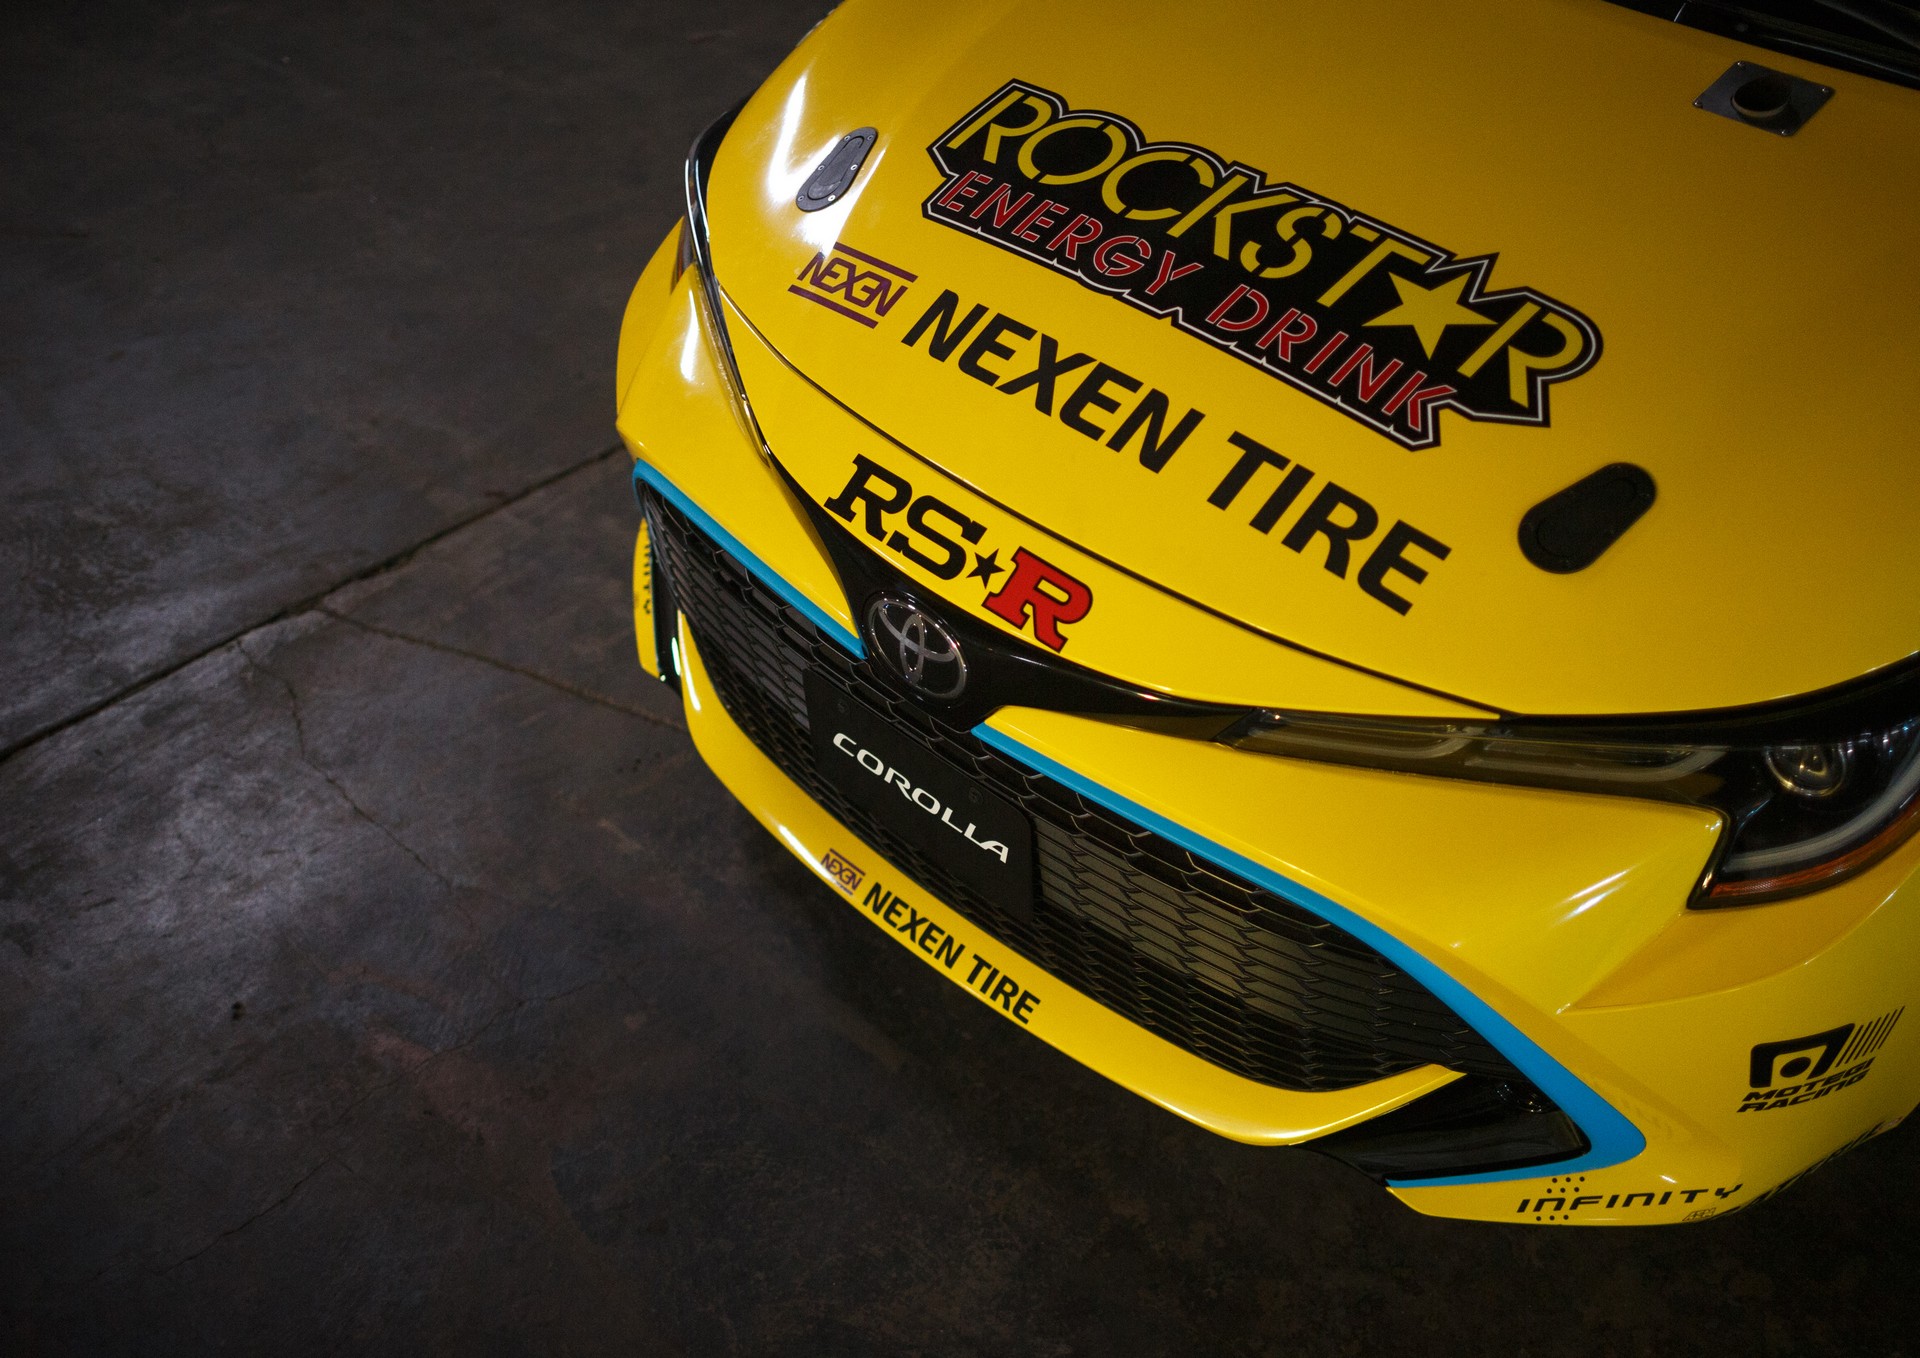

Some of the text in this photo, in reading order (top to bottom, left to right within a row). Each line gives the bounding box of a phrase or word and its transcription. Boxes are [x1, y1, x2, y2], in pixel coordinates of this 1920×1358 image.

[938, 170, 1458, 432] ENERGY DRINK
[797, 251, 1452, 617] NEXEN NEXEN TIRE
[832, 732, 1009, 864] COROLLA
[862, 882, 966, 969] NEXEN
[965, 954, 1041, 1025] TIRE
[1736, 1068, 1870, 1113] RACING
[1742, 1056, 1876, 1102] MOTEGI
[1516, 1183, 1743, 1213] INFINITY
